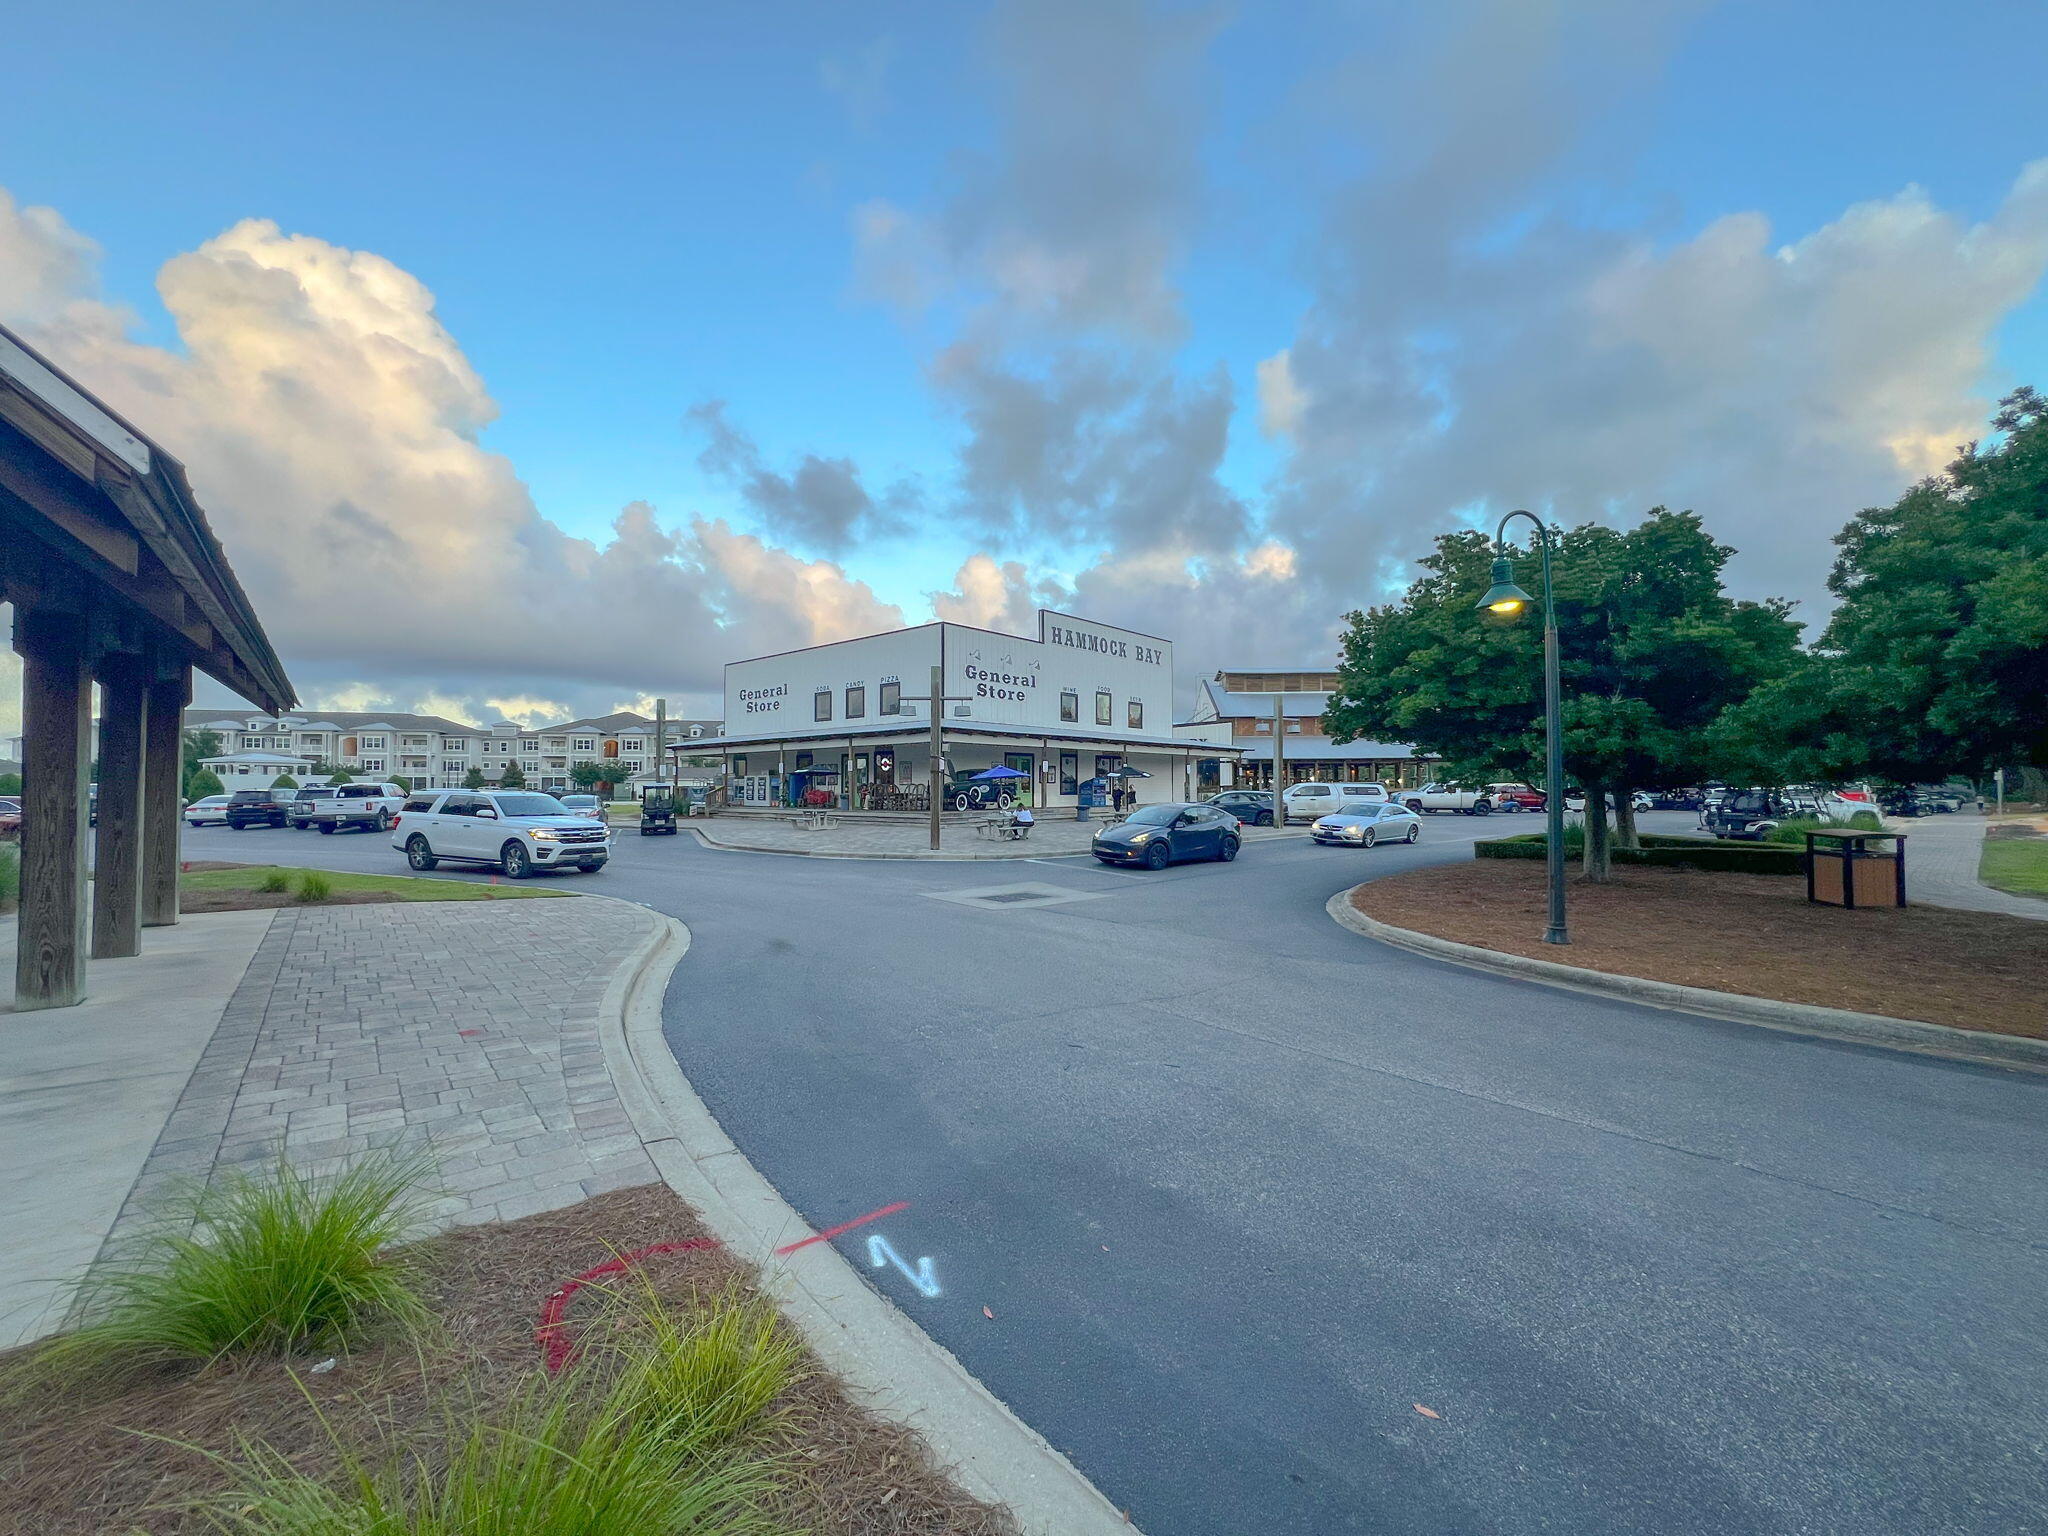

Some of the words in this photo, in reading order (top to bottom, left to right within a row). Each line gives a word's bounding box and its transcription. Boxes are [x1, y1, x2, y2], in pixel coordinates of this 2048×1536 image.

[1051, 626, 1127, 658] HAMMOCK
[1135, 645, 1162, 665] BAY
[845, 680, 864, 688] CANDY
[880, 675, 899, 683] PIZZA
[965, 664, 1037, 688] General
[739, 683, 788, 701] General
[976, 683, 1026, 702] Store
[746, 700, 780, 713] Store
